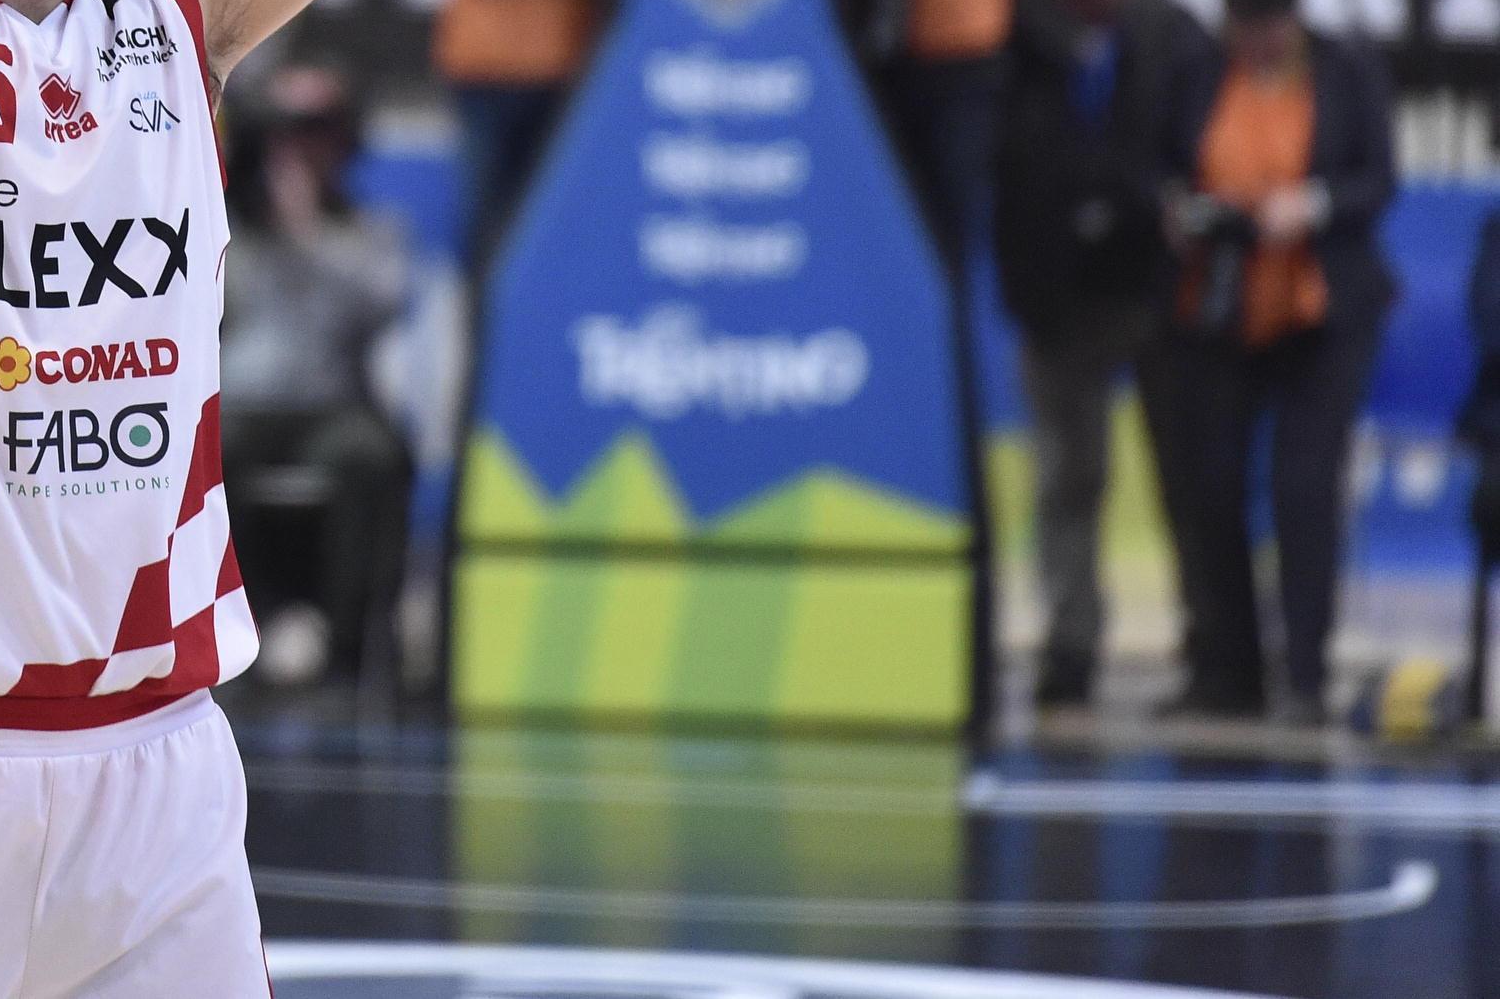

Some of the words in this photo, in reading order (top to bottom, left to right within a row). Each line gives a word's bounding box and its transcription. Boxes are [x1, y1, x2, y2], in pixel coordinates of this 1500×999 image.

[35, 338, 179, 385] CONAD
[3, 402, 170, 475] FABO
[6, 482, 50, 498] TAPE
[61, 476, 170, 496] SOLUTIONS
